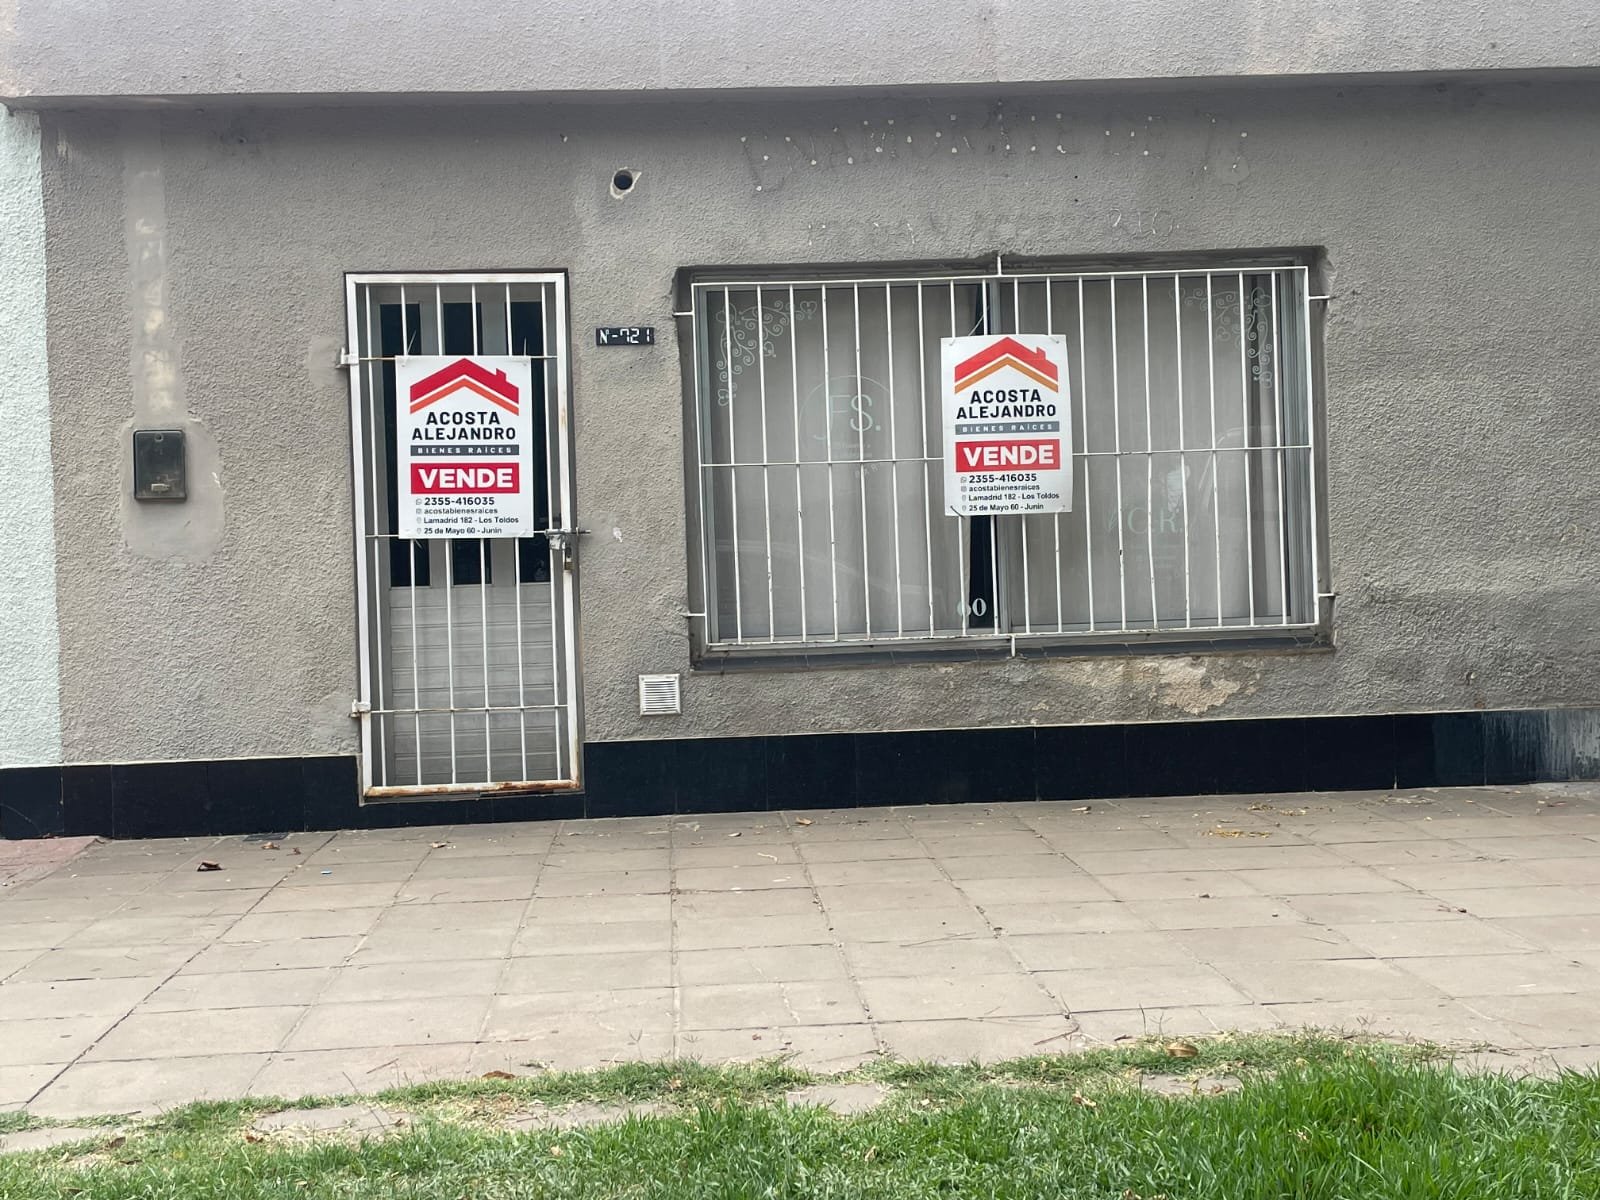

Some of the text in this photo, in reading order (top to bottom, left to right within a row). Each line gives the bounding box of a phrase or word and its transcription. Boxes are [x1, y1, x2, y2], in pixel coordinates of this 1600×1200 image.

[970, 388, 1042, 404] ACOSTA
[956, 404, 1056, 419] ALEJANDRO
[426, 412, 501, 425] ACOSTA
[962, 423, 1053, 433] BIENES RAÍCES
[412, 427, 516, 440] ALEJANDRO
[468, 446, 512, 454] RAÍCES
[964, 444, 1054, 466] VENDE
[418, 468, 514, 489] VENDE
[968, 474, 1037, 483] 2355-416035
[968, 484, 1040, 492] acostabienesraices
[424, 496, 495, 506] 2355-416035
[424, 507, 498, 515] acostabienesraices
[990, 504, 1009, 512] Mayo
[495, 516, 519, 524] Toldos
[445, 527, 466, 536] Mayo
